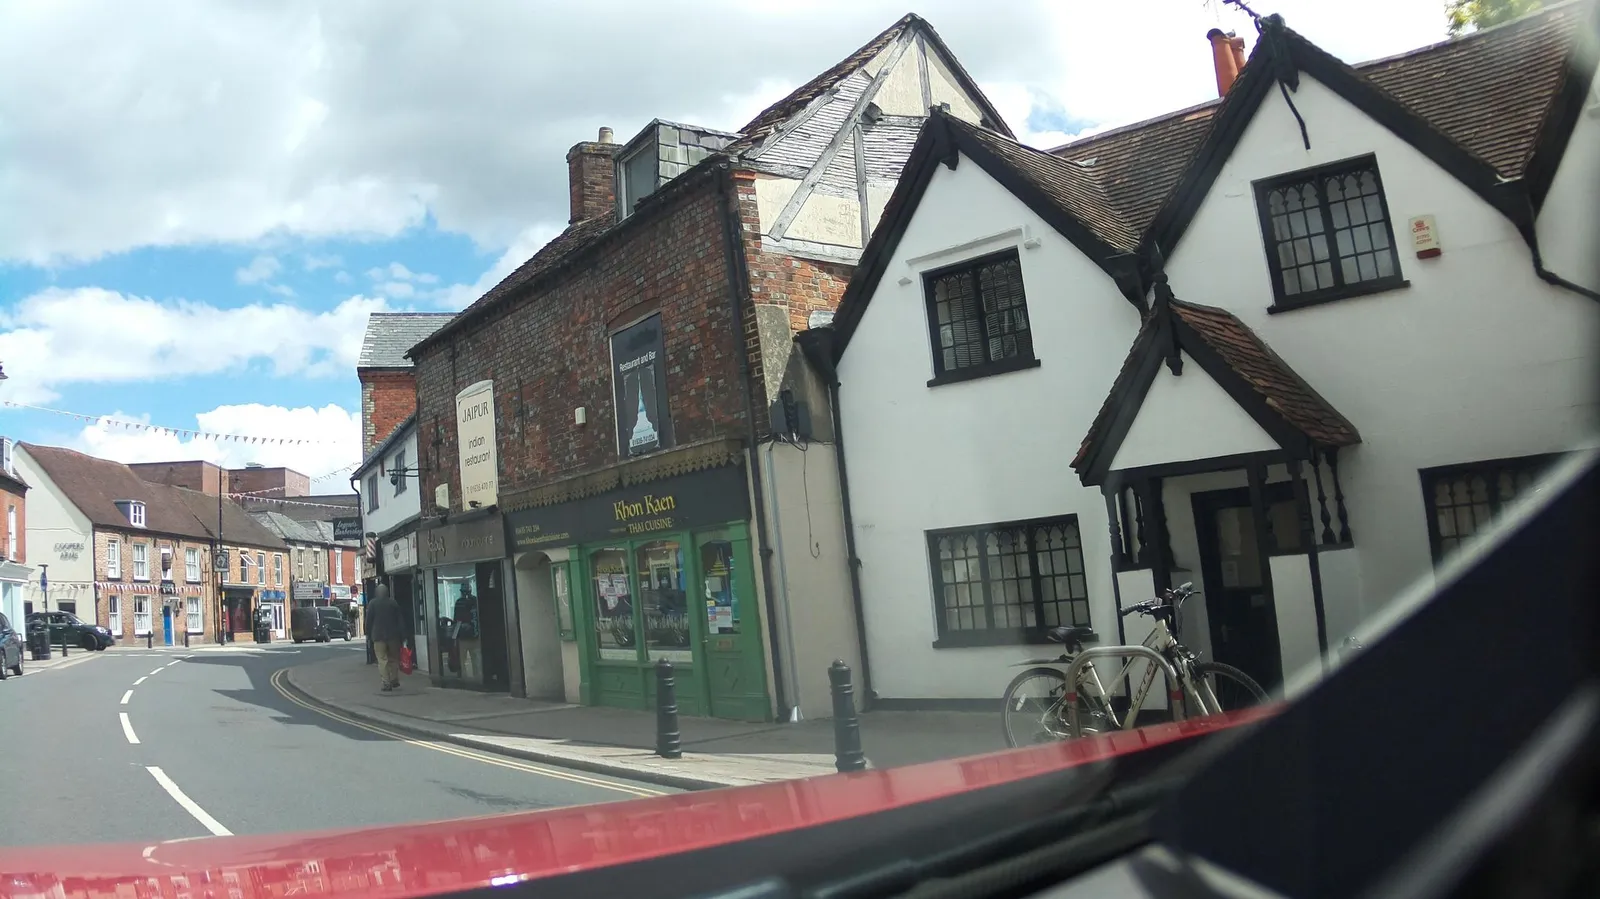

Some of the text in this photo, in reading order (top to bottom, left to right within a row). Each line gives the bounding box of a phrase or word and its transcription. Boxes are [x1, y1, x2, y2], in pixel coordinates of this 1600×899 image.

[619, 356, 641, 373] Restaurant
[462, 401, 489, 423] JAIPUR
[468, 436, 486, 449] indian
[464, 450, 491, 467] restaurant
[612, 494, 676, 521] Khon Kaen
[628, 517, 673, 534] THAI CUISINE
